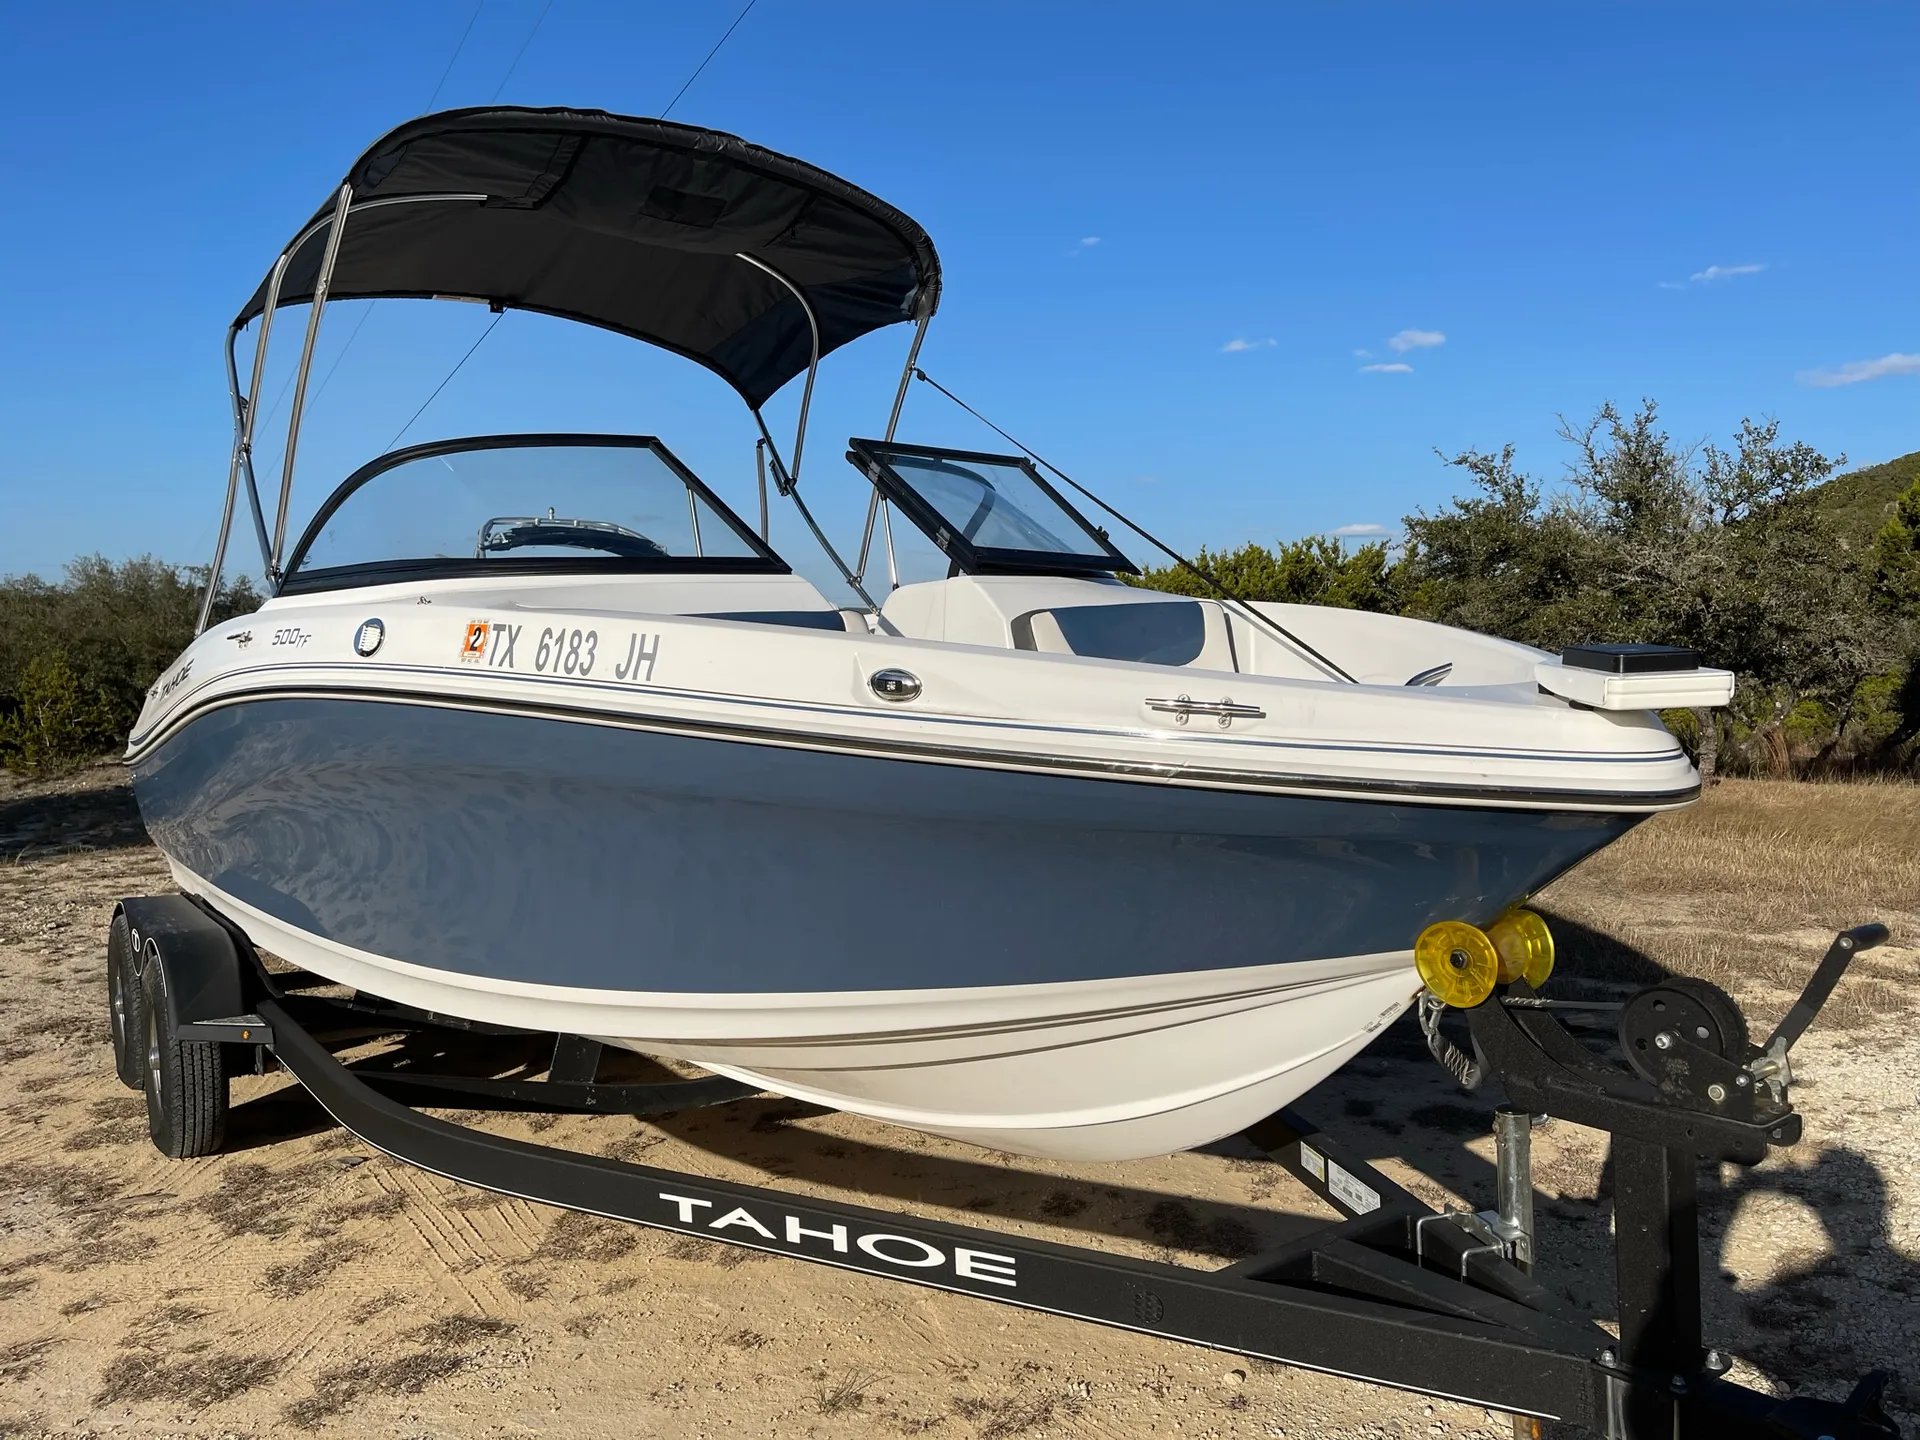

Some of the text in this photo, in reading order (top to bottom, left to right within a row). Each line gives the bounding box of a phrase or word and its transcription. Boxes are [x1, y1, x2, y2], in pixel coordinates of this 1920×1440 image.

[271, 627, 312, 648] 500TF
[469, 626, 482, 652] 2
[488, 623, 660, 682] TX 6183 JH
[659, 1192, 1017, 1287] TAHOE
